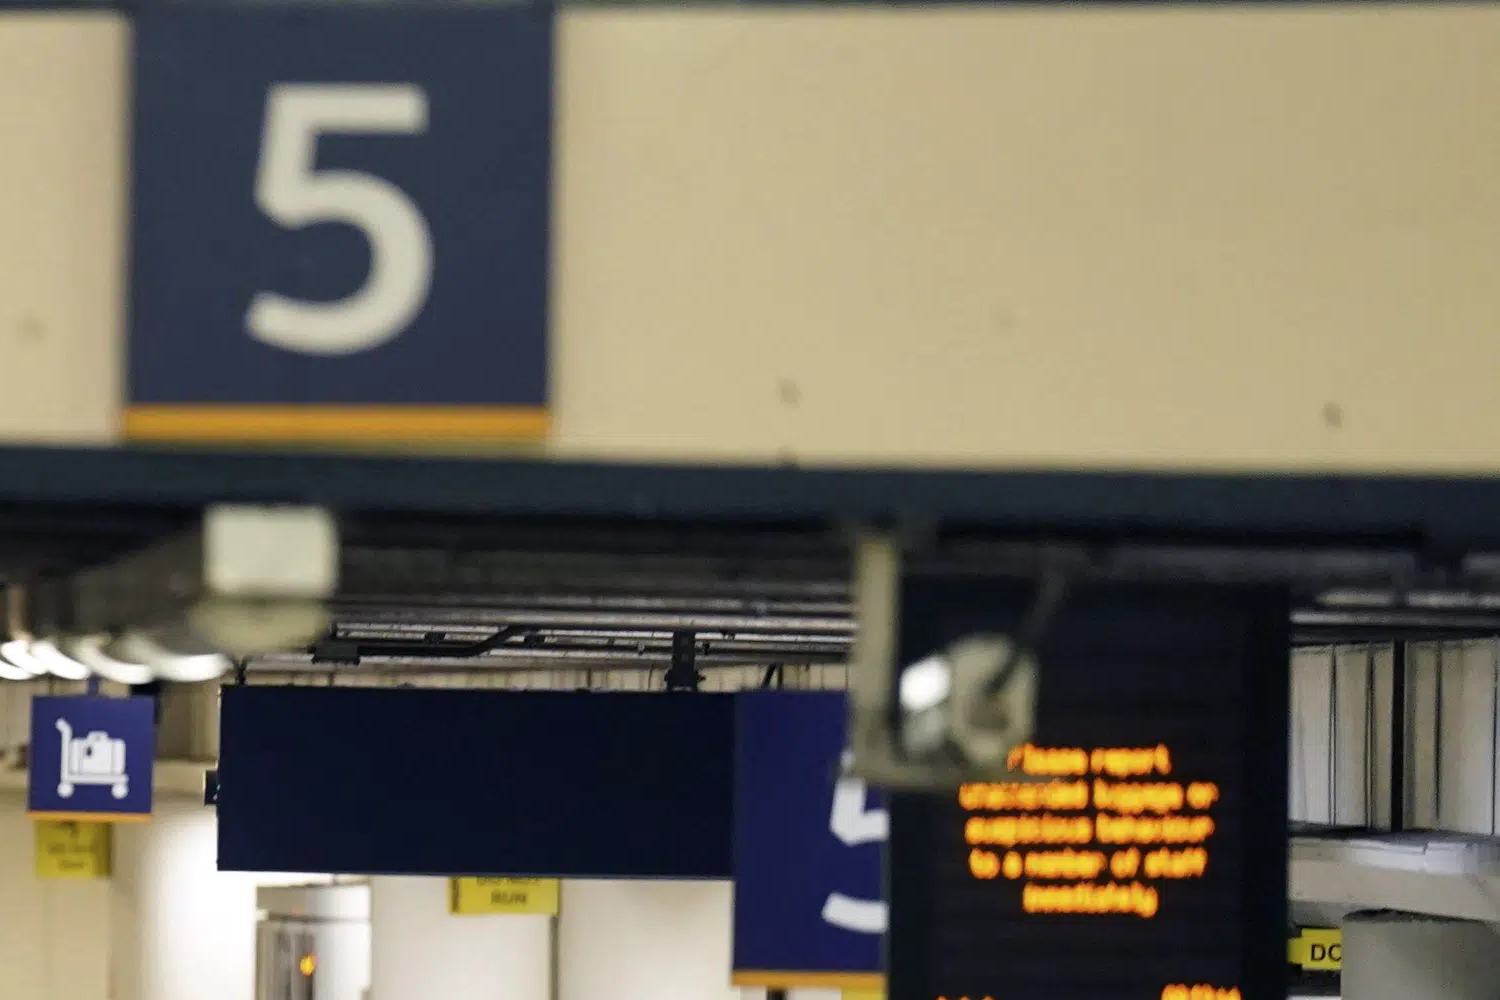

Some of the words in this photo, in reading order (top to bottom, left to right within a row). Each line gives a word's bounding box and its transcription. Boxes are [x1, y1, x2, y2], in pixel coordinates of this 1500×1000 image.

[244, 80, 435, 358] 5
[1090, 744, 1171, 777] report
[1093, 776, 1184, 815] luggage
[964, 812, 1092, 847] suspicious
[1096, 811, 1215, 845] behaviour
[968, 847, 999, 879] to
[1002, 850, 1023, 879] a
[1024, 847, 1107, 879] member
[1110, 846, 1141, 879] of
[1143, 846, 1208, 879] staff
[1022, 881, 1159, 918] immediately
